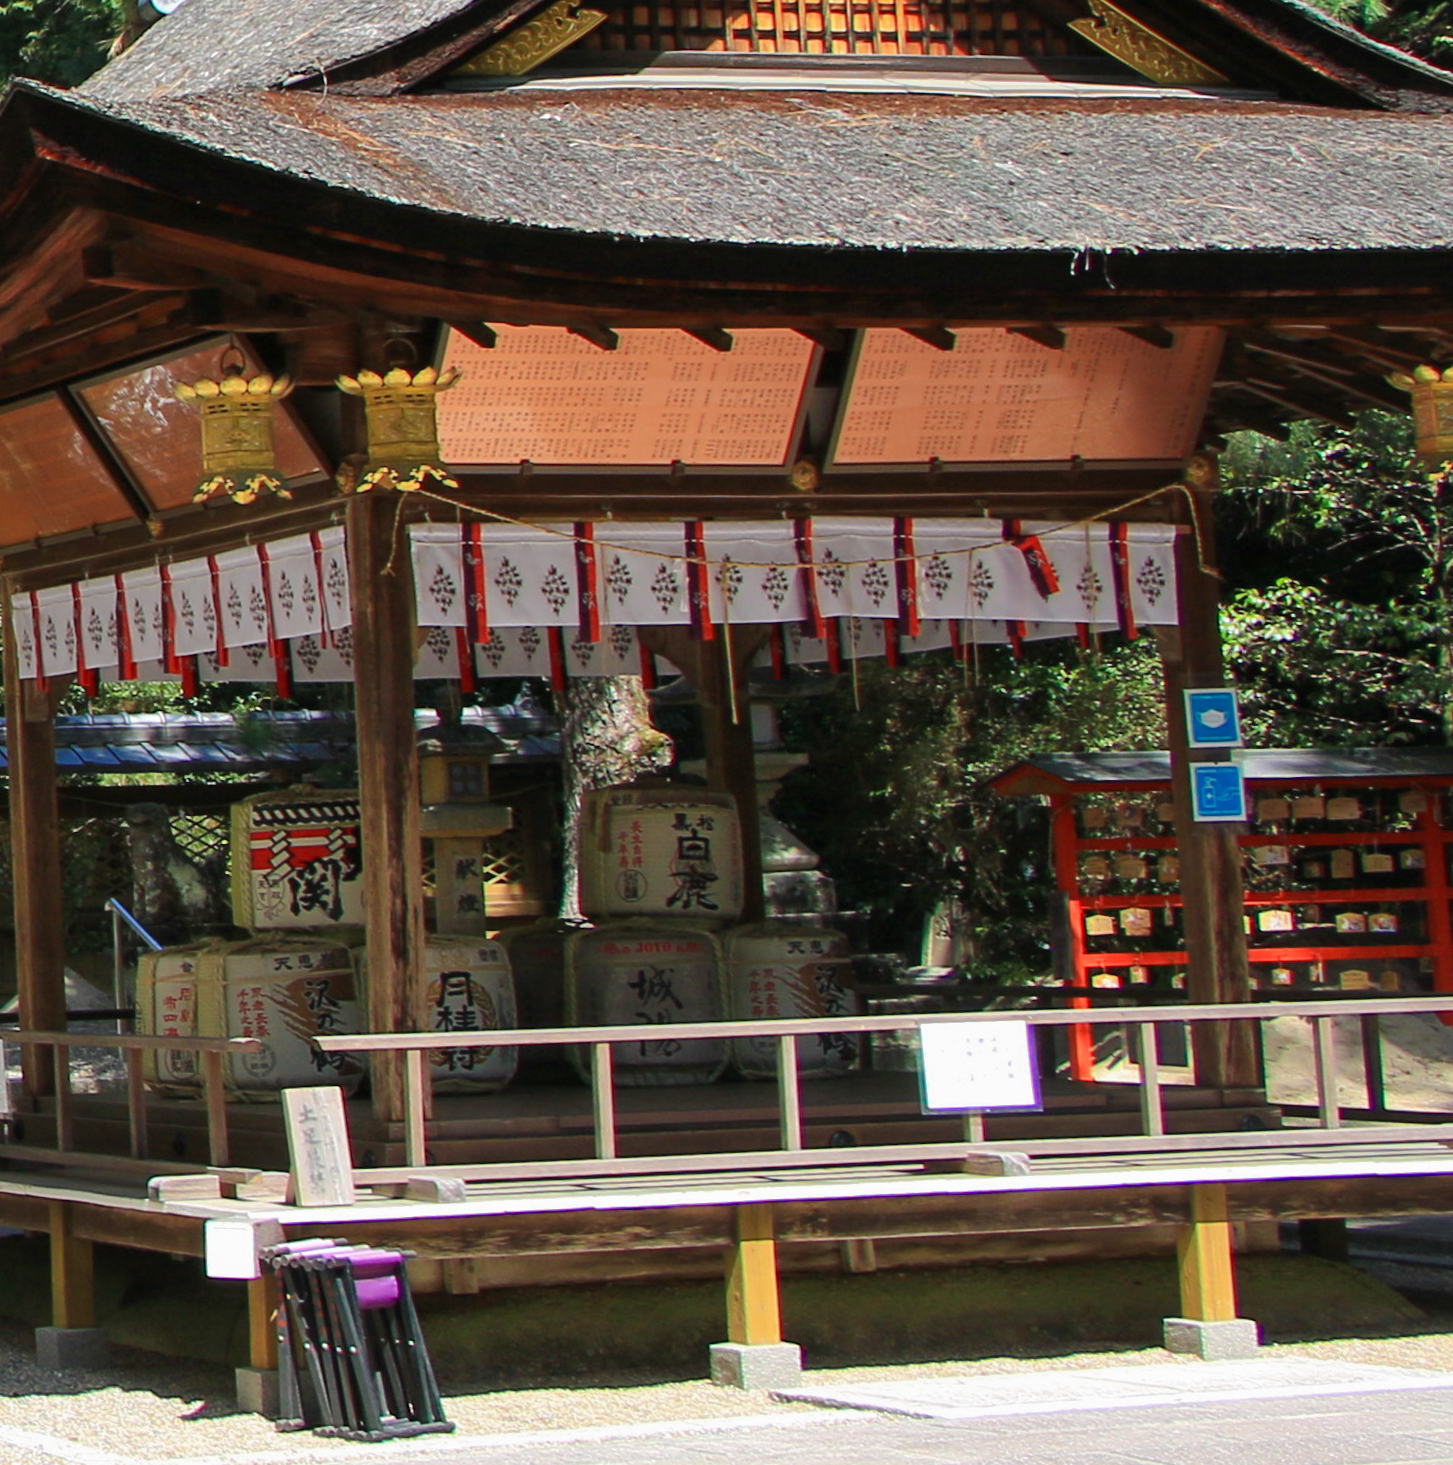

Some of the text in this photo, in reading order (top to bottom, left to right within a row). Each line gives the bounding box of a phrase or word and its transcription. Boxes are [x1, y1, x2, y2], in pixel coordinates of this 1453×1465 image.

[666, 827, 720, 910] 白鹿
[635, 941, 672, 954] JOYO
[304, 979, 346, 1073] 沢の鶴
[434, 970, 480, 1072] 月桂冠
